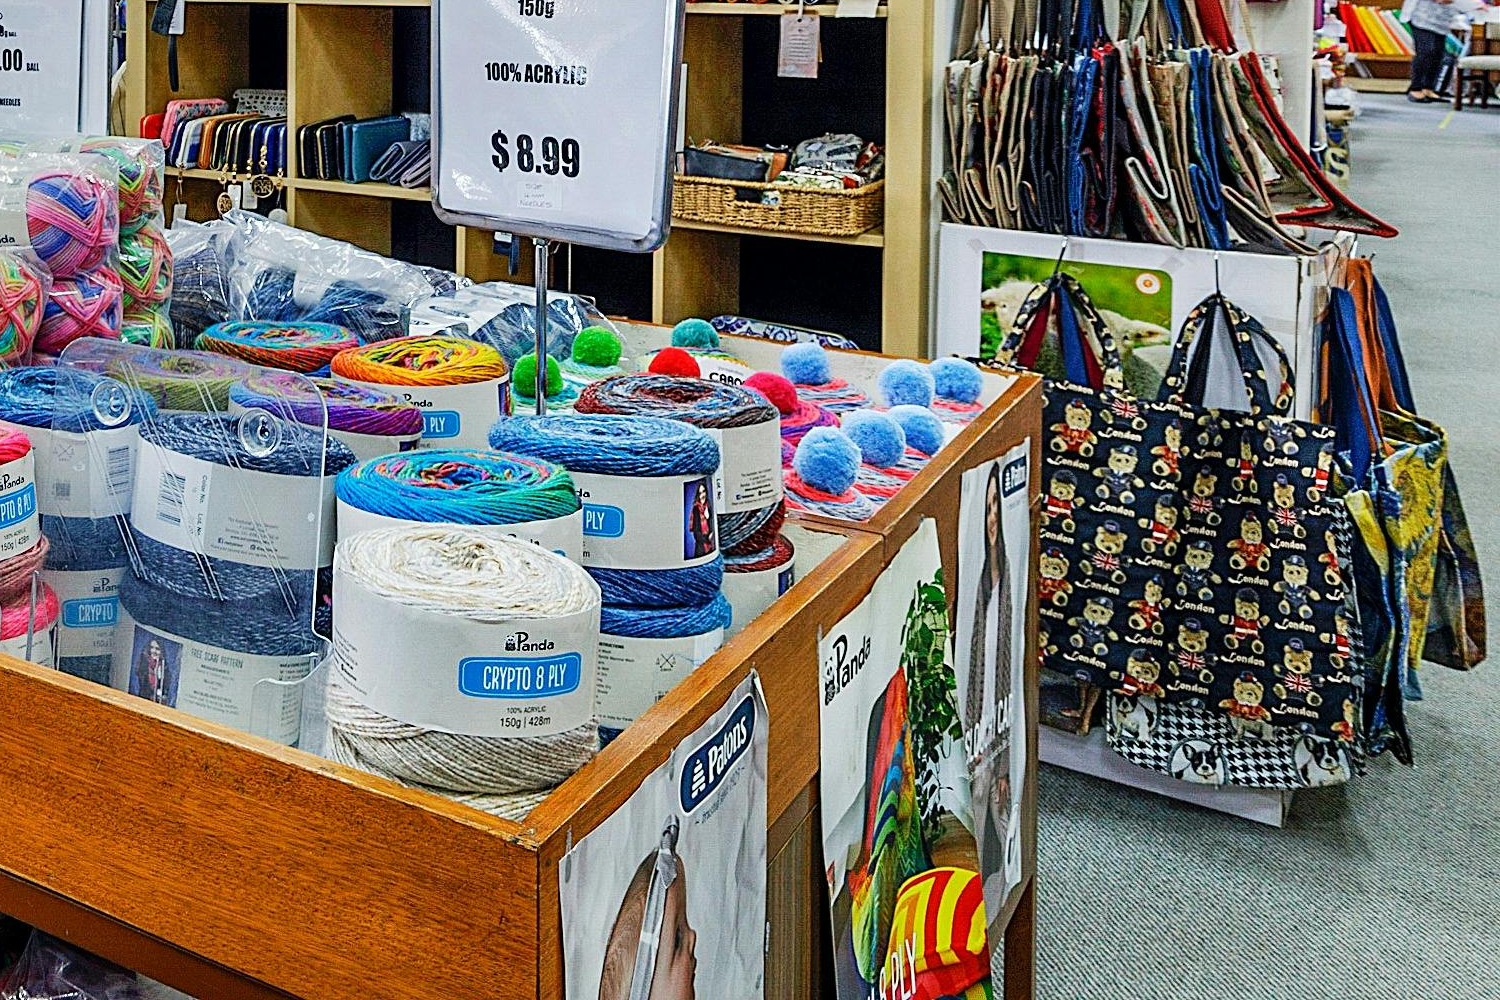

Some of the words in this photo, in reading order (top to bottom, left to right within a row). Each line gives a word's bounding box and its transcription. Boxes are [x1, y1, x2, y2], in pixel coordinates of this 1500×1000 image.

[26, 62, 40, 72] BALL
[484, 62, 522, 83] 100%
[524, 63, 587, 86] ACRYLIC
[0, 98, 21, 106] NEEDLES
[491, 129, 510, 174] $
[516, 133, 580, 178] 8.99
[430, 416, 446, 433] PLY
[2, 473, 26, 491] Panda
[17, 497, 23, 516] 8
[23, 493, 33, 514] PLY
[1089, 501, 1136, 518] London
[585, 510, 605, 530] PLY
[100, 577, 118, 592] Pan
[1074, 579, 1121, 596] London
[1227, 571, 1270, 587] London
[78, 602, 114, 623] CRYPTO
[1174, 599, 1216, 615] London
[1273, 618, 1316, 634] London
[514, 631, 555, 652] Panda
[220, 655, 244, 669] PATTERN
[832, 634, 871, 695] Panda
[1063, 652, 1108, 670] London
[1220, 653, 1266, 668] London
[483, 665, 532, 691] CRYPTO
[535, 664, 544, 690] 8
[548, 663, 567, 688] PLY
[1166, 680, 1210, 696] London
[506, 706, 523, 714] 100%
[523, 705, 547, 713] ACRYLIC
[1271, 704, 1319, 720] London
[500, 717, 522, 729] 150g
[528, 715, 551, 727] 428m
[707, 715, 748, 784] Patons
[891, 932, 916, 1000] PLY
